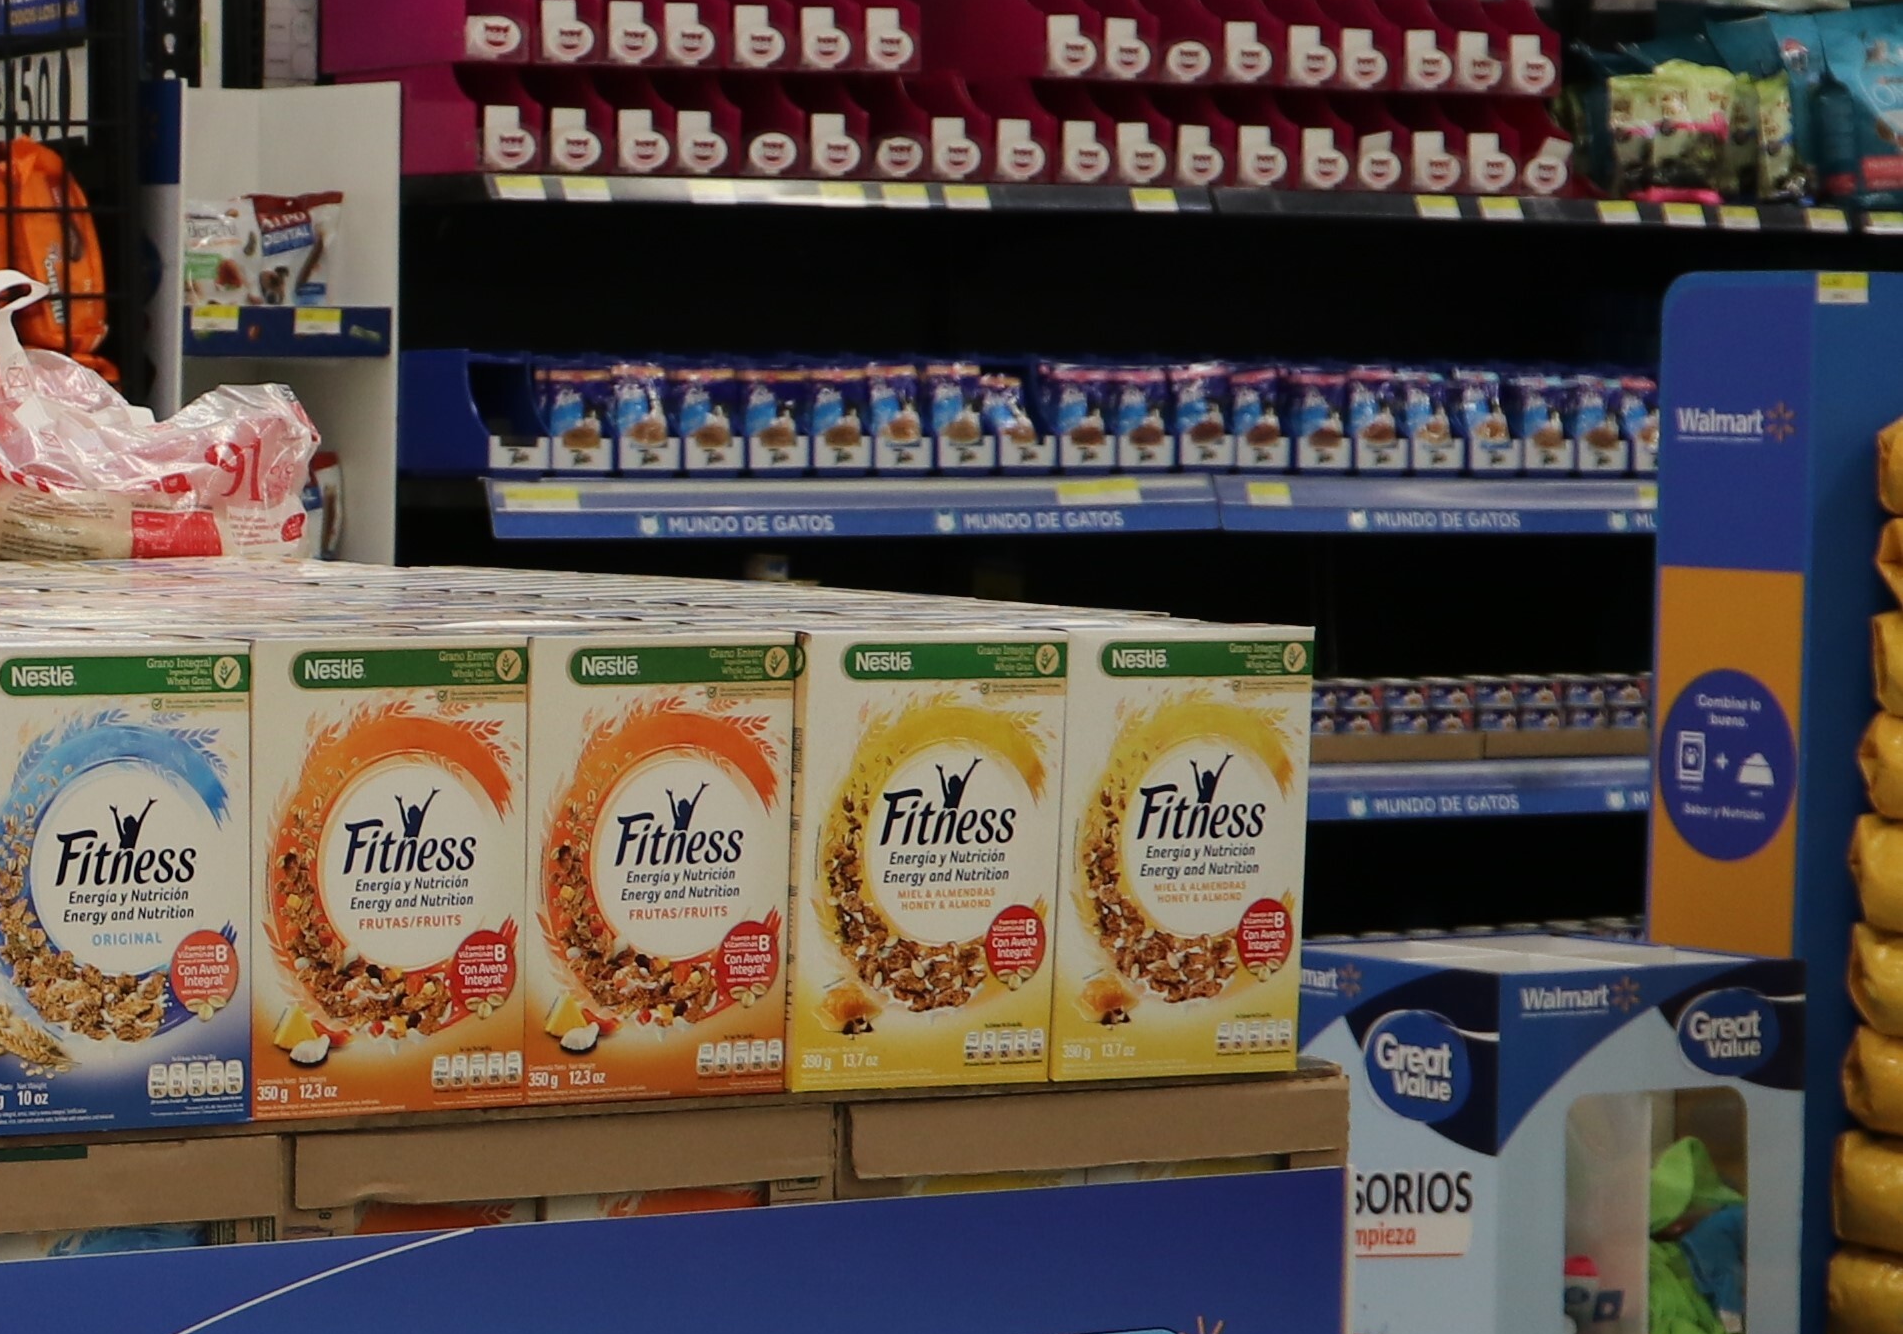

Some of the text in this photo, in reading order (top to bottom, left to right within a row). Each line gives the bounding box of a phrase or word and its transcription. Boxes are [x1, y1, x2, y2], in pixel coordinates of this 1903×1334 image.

[1678, 406, 1763, 435] Walmart
[668, 514, 835, 533] MUNDO DE GATOS
[1376, 793, 1520, 815] MUNDO DE GATOS
[358, 915, 462, 931] FRUTAS/FRUITS
[1520, 985, 1609, 1011] Walmart
[1689, 1010, 1762, 1041] Great
[1374, 1033, 1452, 1078] Great
[1706, 1038, 1762, 1059] Value
[1395, 1070, 1452, 1102] Value
